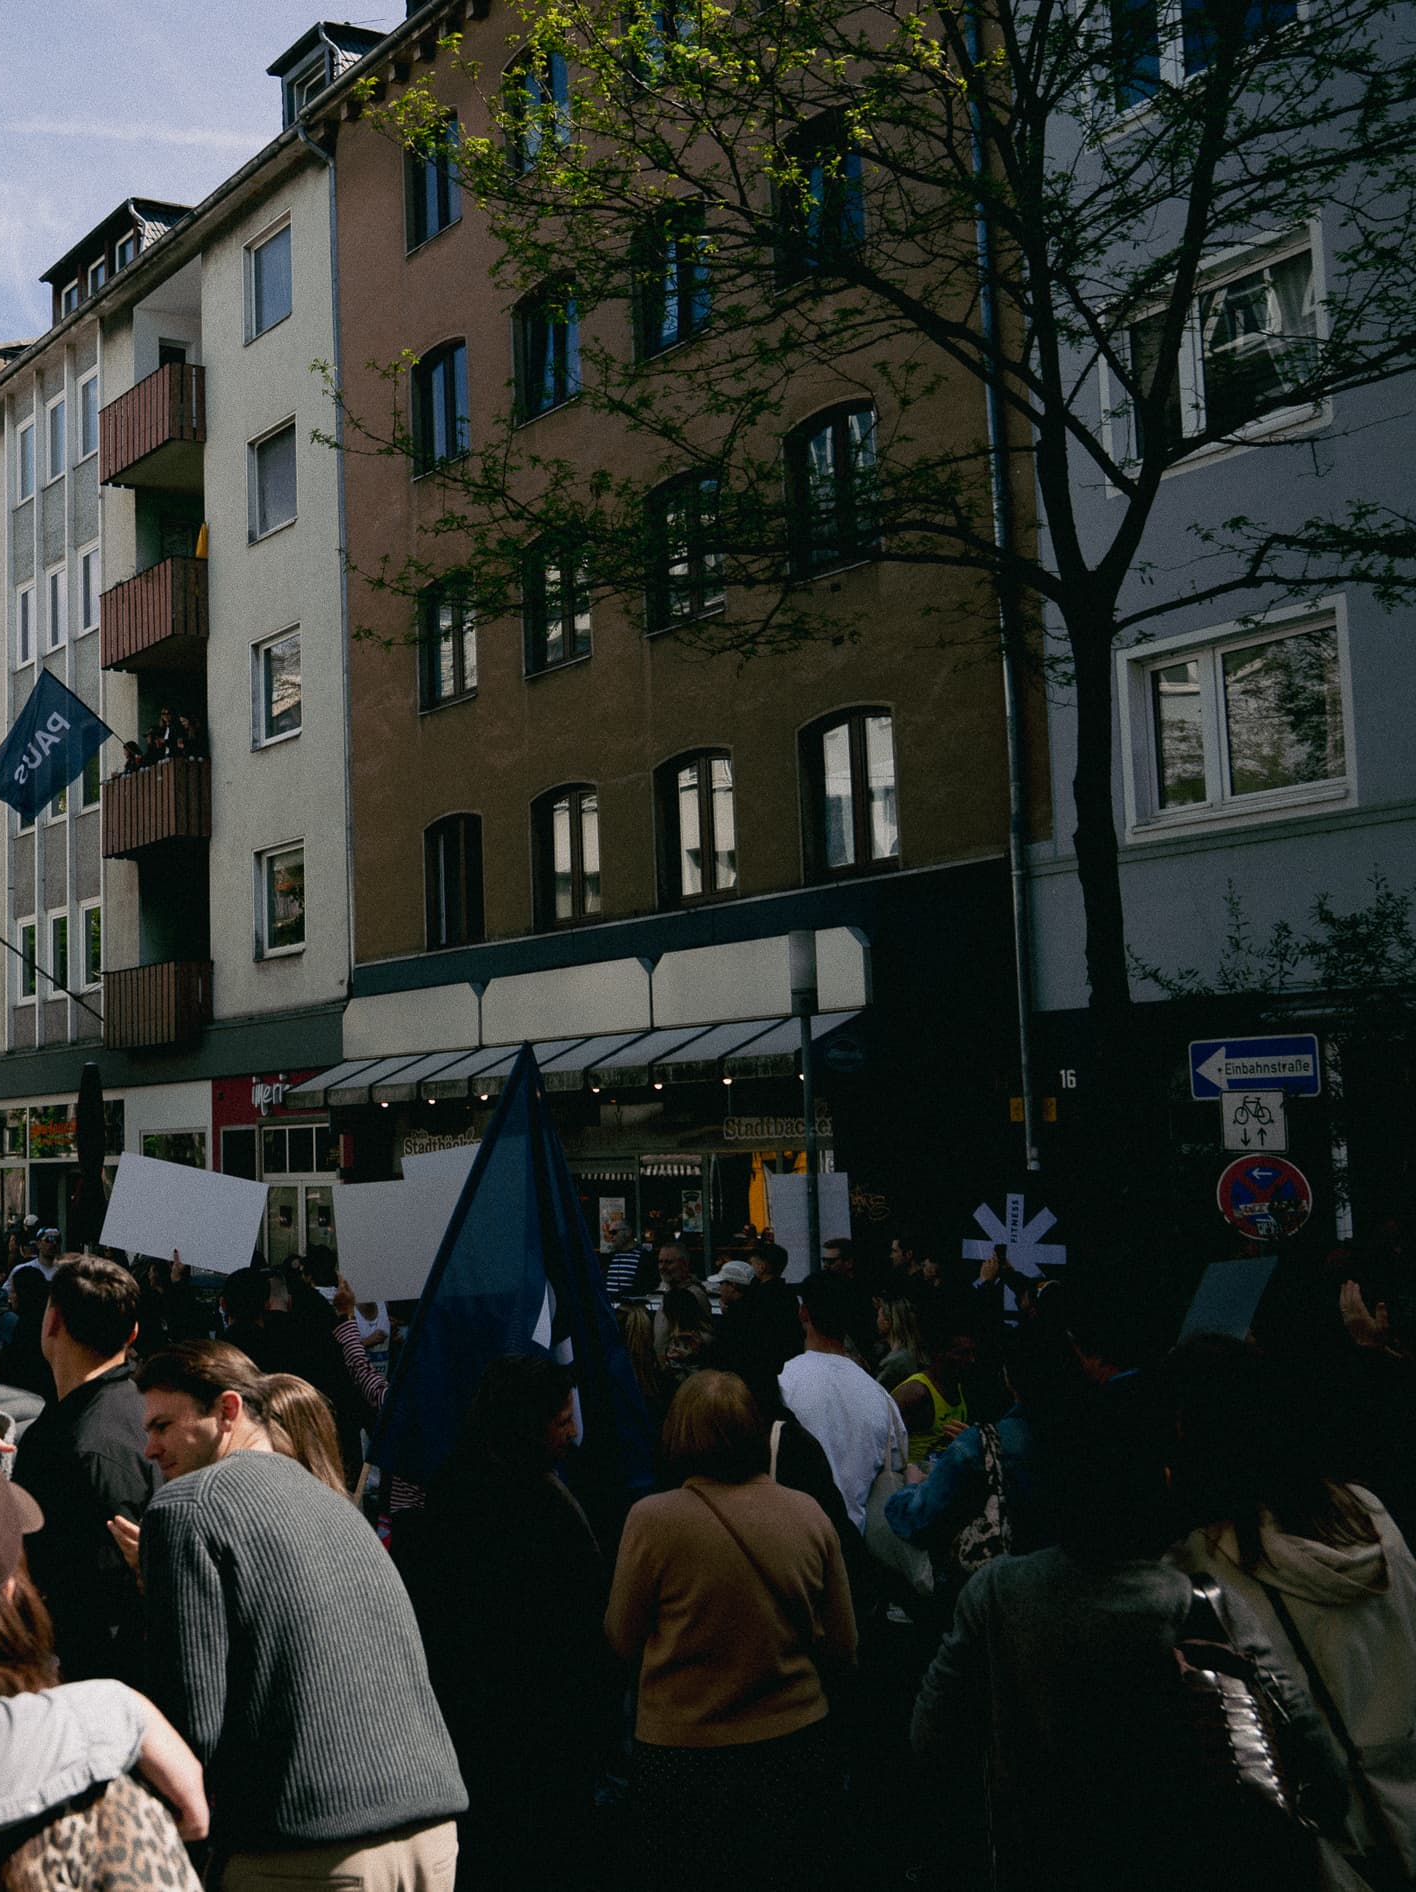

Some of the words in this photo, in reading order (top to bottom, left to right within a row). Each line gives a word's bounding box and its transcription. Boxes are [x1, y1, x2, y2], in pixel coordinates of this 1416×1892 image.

[1225, 1059, 1310, 1075] Einbahnstraße
[1059, 1068, 1077, 1088] 16
[726, 1116, 833, 1137] Stadtbäce
[1011, 1200, 1019, 1243] FITNESS
